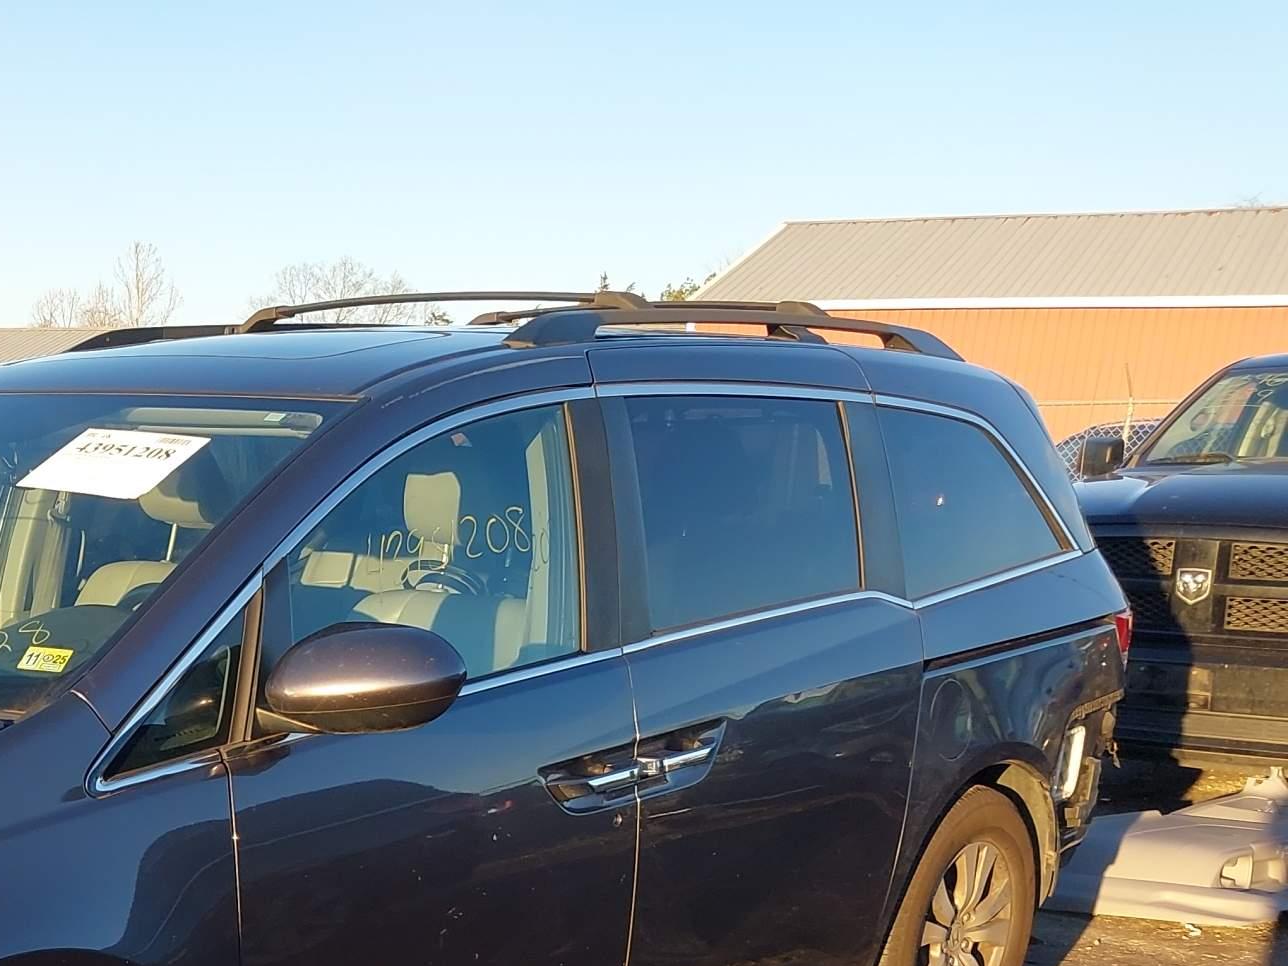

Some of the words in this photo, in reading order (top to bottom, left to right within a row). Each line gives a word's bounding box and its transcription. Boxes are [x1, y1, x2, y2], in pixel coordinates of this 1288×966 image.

[77, 442, 176, 460] 43951208
[26, 652, 41, 665] 11
[53, 654, 68, 665] 25
